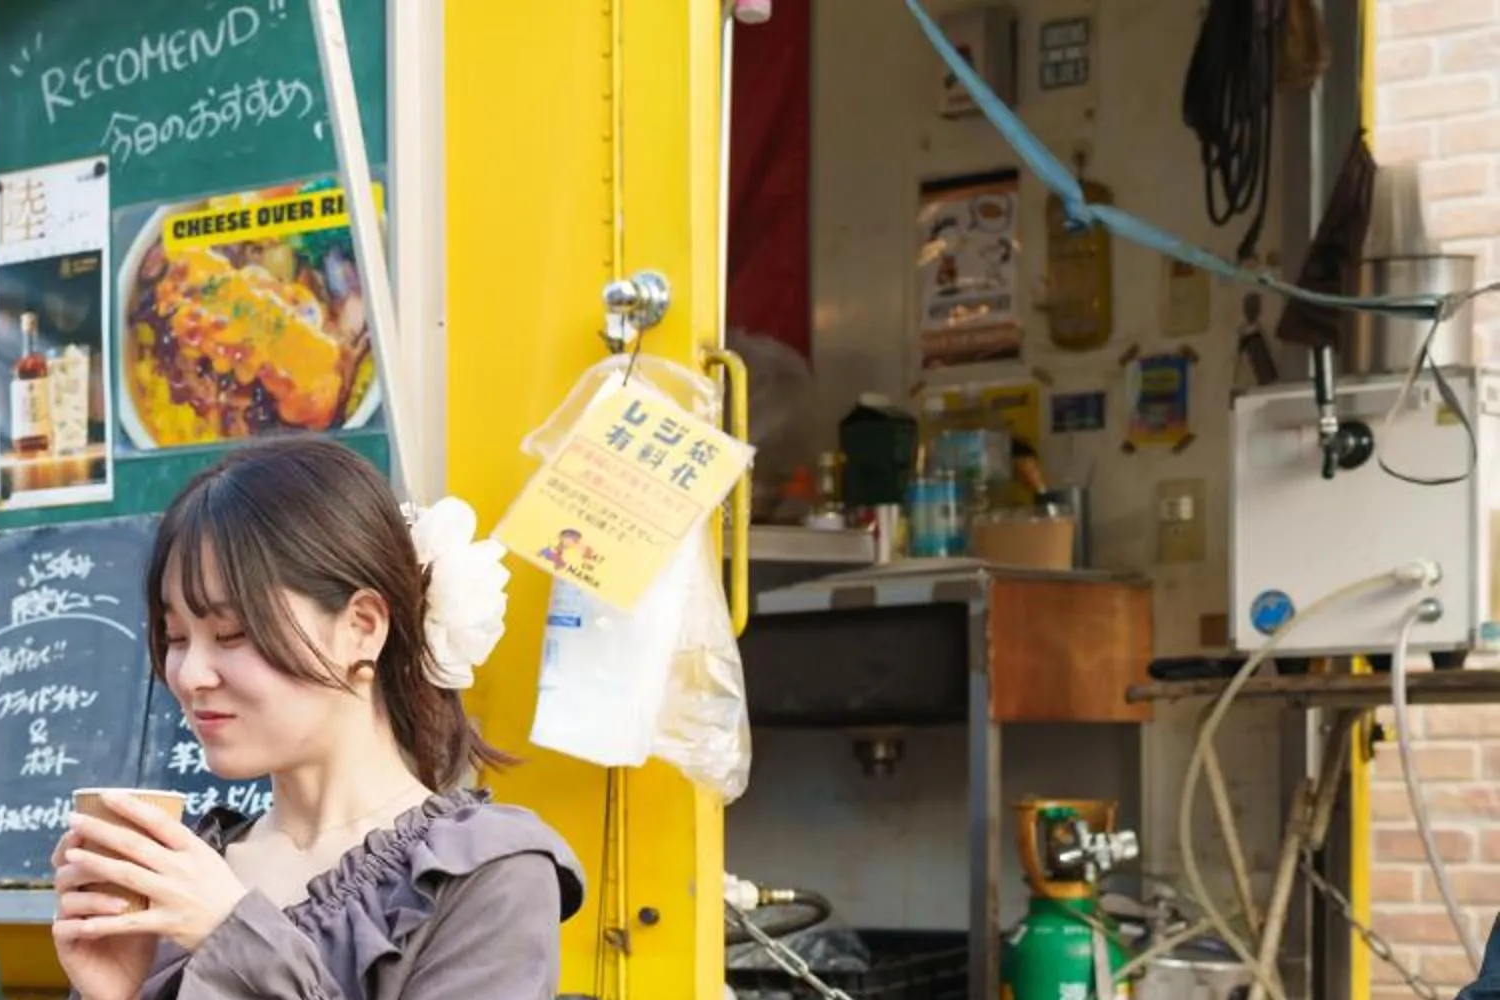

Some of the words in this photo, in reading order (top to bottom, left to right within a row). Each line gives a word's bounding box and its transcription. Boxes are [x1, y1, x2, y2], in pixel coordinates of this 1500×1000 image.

[101, 76, 313, 164] 今日のおすすめ
[172, 210, 252, 239] CHEESE
[257, 199, 314, 227] OVER
[321, 194, 345, 216] RI
[605, 424, 698, 491] 有料化
